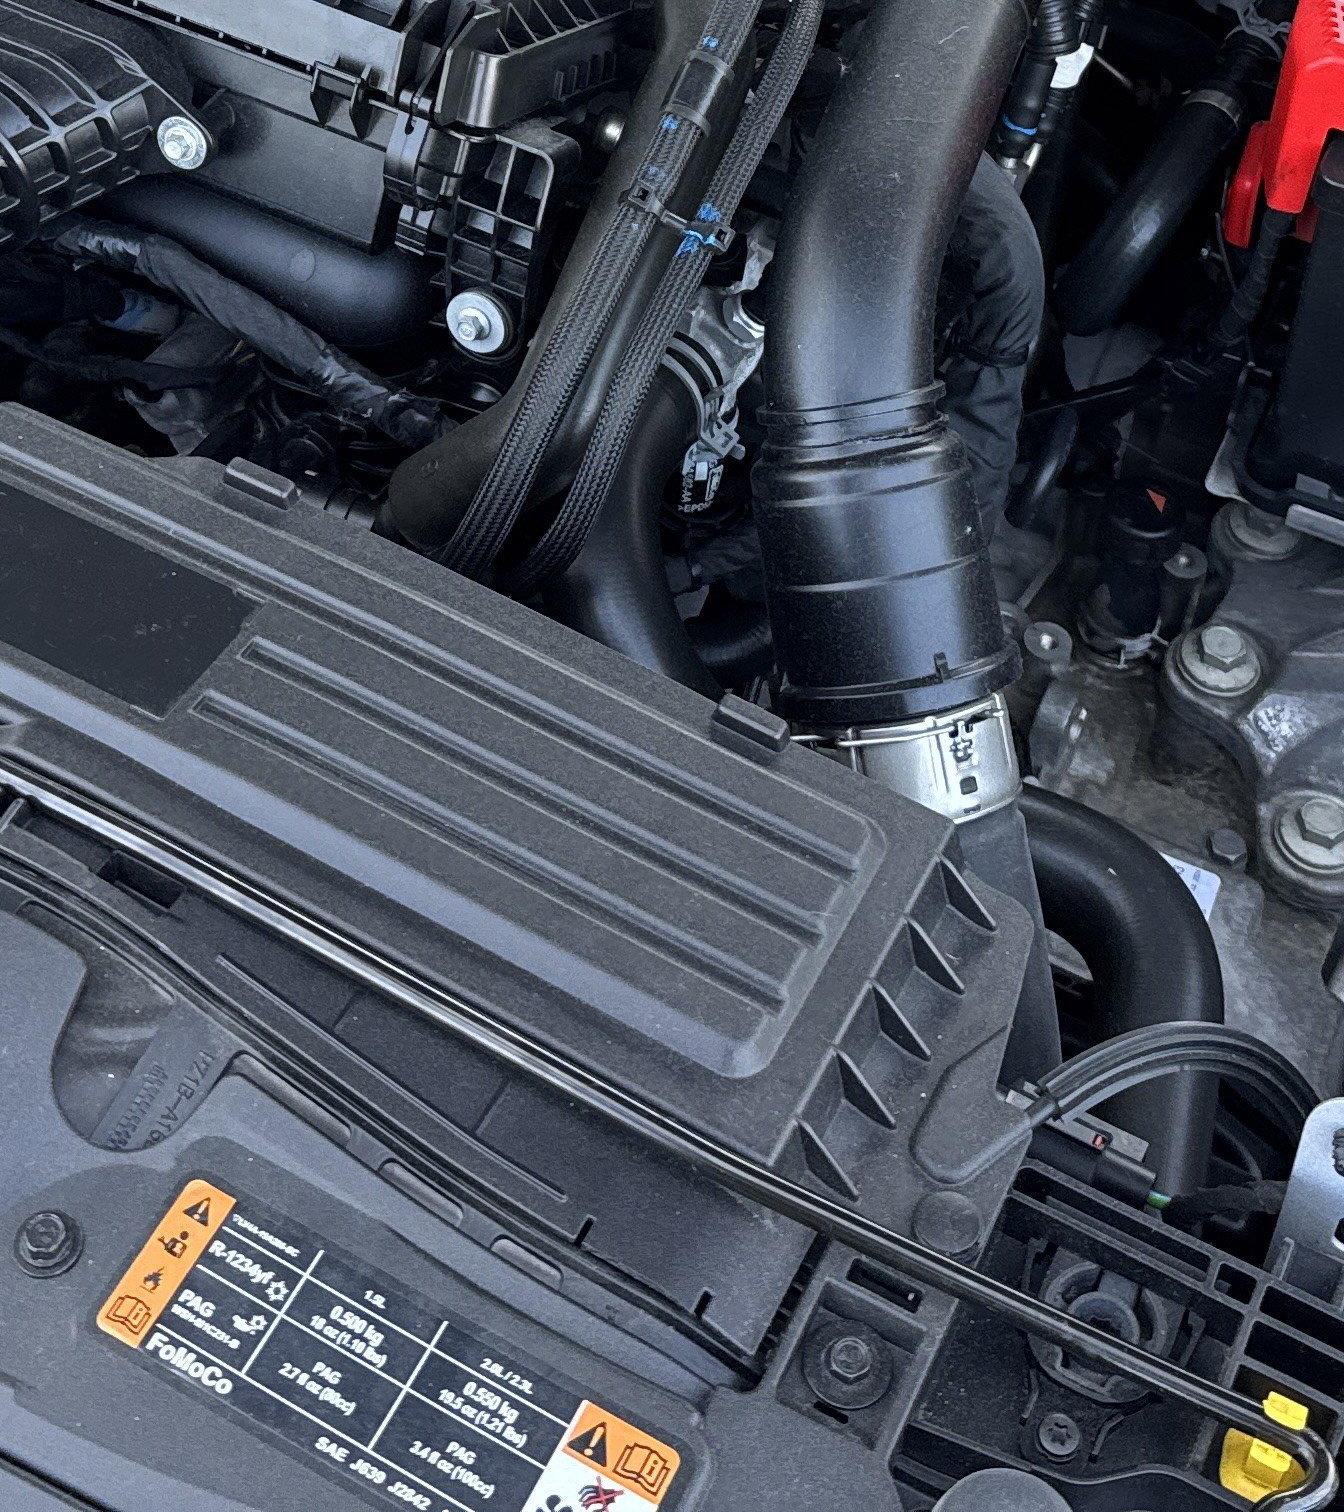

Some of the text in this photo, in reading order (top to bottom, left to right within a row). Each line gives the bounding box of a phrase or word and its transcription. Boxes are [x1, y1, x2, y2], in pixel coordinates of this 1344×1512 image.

[209, 1240, 275, 1284] R-1234yf
[178, 1289, 216, 1317] PAG
[323, 1326, 340, 1339] oz
[330, 1306, 384, 1347] 0.500 kg
[145, 1332, 232, 1394] FoMoCo
[312, 1362, 342, 1384] PAG
[305, 1377, 323, 1394] oz
[461, 1405, 478, 1418] oz
[463, 1382, 519, 1424] 0.550 kg
[315, 1437, 350, 1462] SAE
[349, 1459, 387, 1484] J639
[445, 1442, 476, 1464] PAG
[437, 1460, 454, 1473] oz
